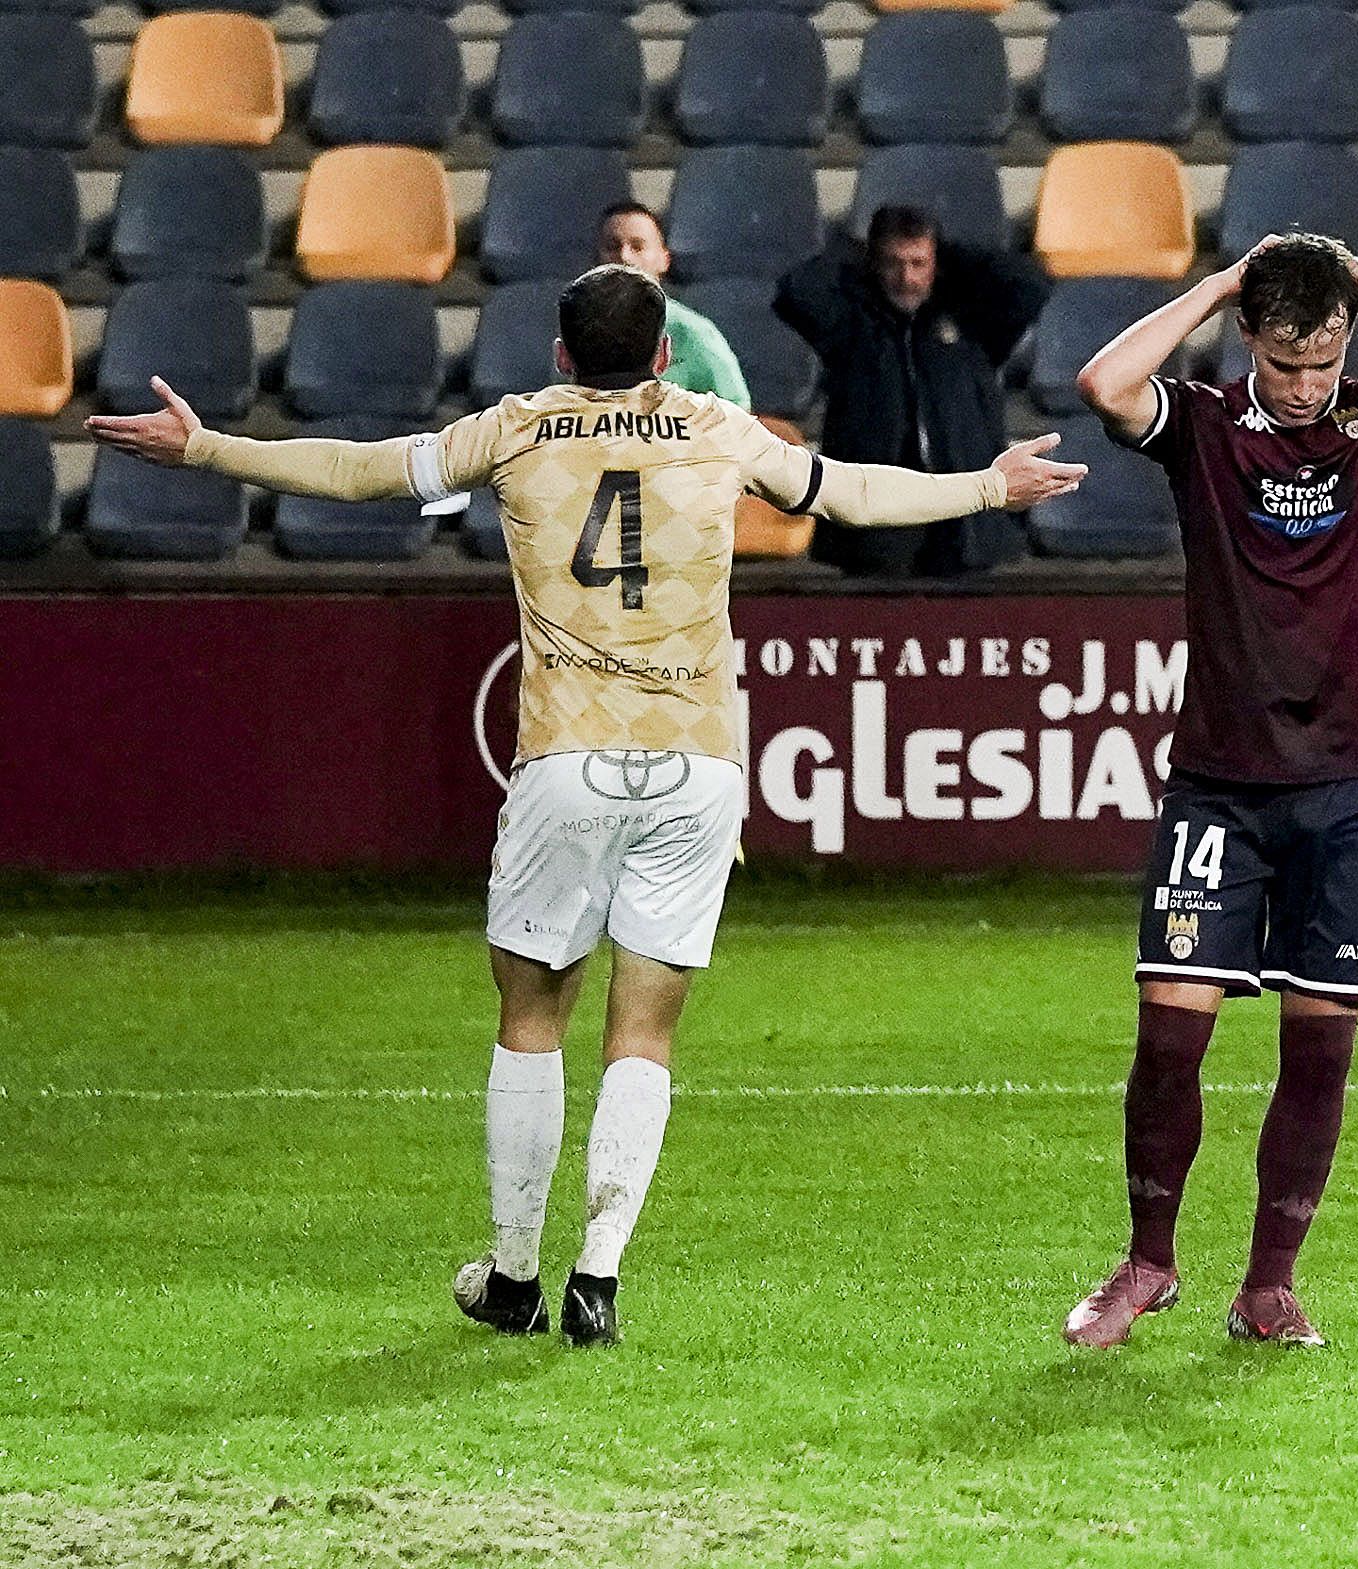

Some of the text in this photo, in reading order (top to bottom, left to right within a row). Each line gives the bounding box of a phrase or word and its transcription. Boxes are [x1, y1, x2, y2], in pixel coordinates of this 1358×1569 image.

[534, 411, 691, 443] ABLANQUE
[1262, 493, 1335, 517] Galicia
[571, 470, 649, 610] 4
[737, 679, 1175, 854] GLESIA
[1168, 821, 1226, 890] 14
[1169, 898, 1223, 911] DE GALICIA
[1170, 889, 1205, 900] XUNTA
